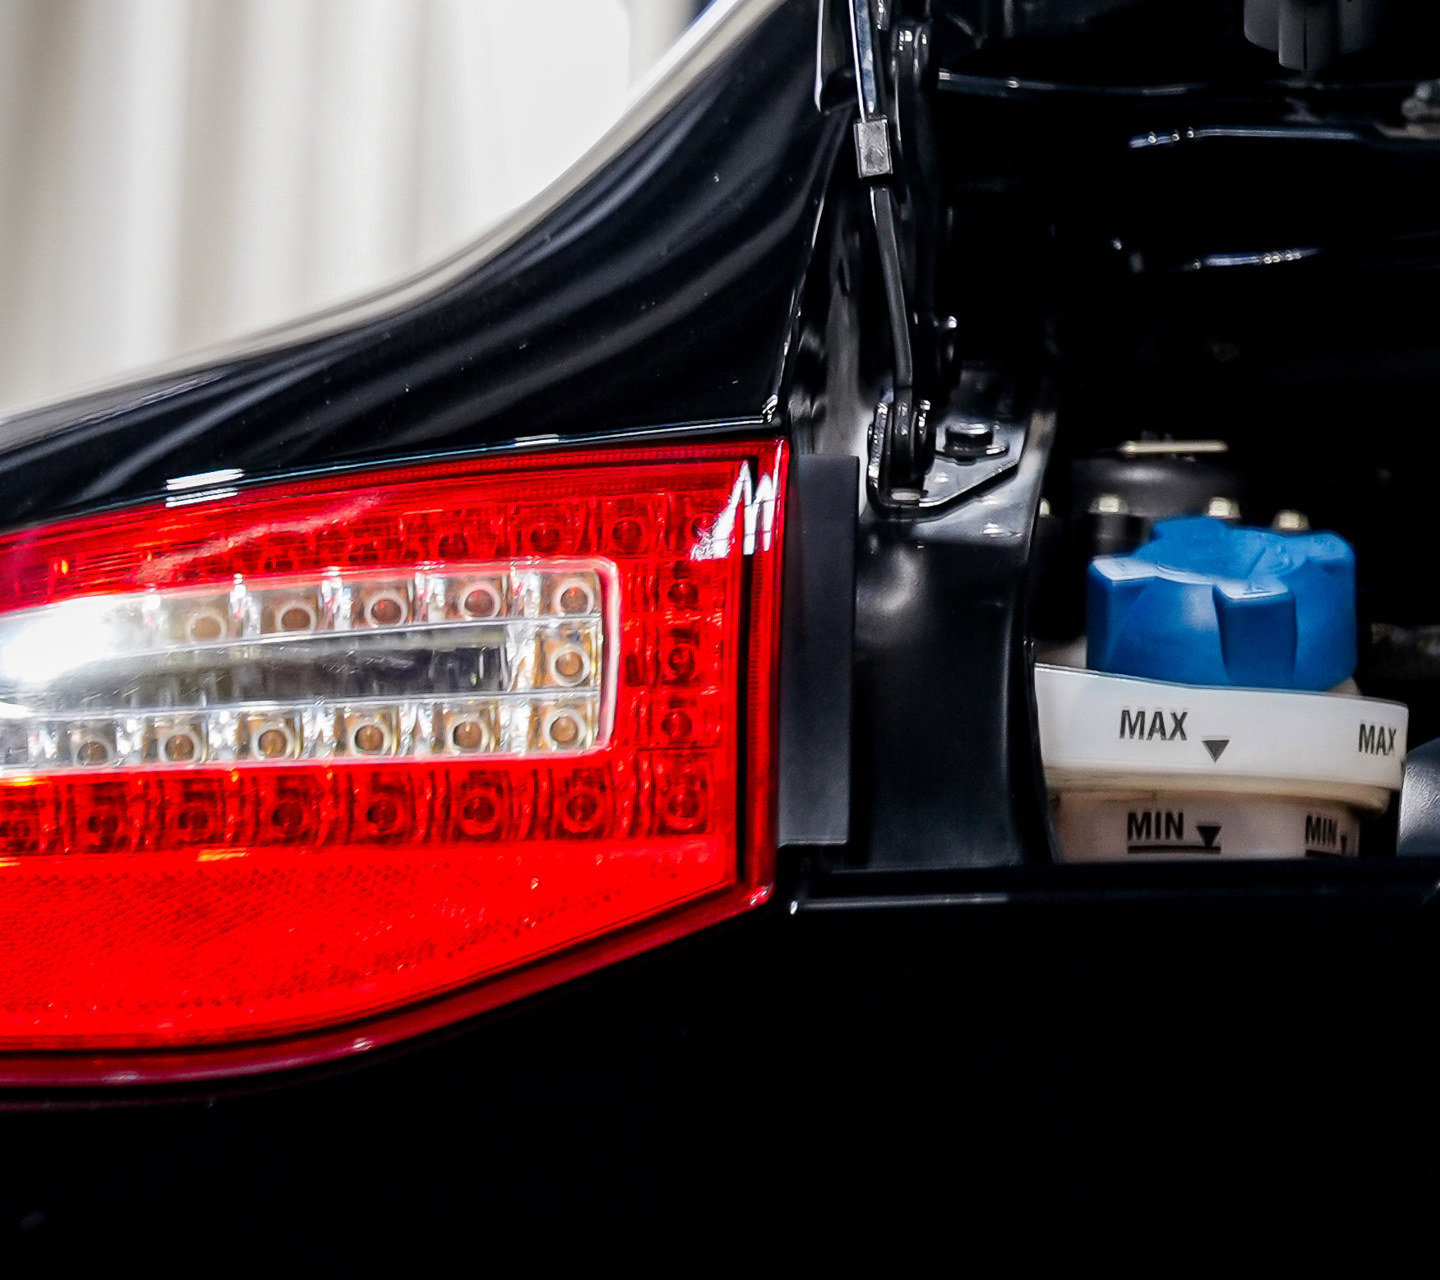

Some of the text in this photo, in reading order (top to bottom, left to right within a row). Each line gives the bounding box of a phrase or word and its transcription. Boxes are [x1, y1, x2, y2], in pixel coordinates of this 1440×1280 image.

[1119, 710, 1189, 741] MAX
[1358, 723, 1397, 757] MAX
[1127, 812, 1184, 840] MIN
[1305, 815, 1338, 847] MIN
